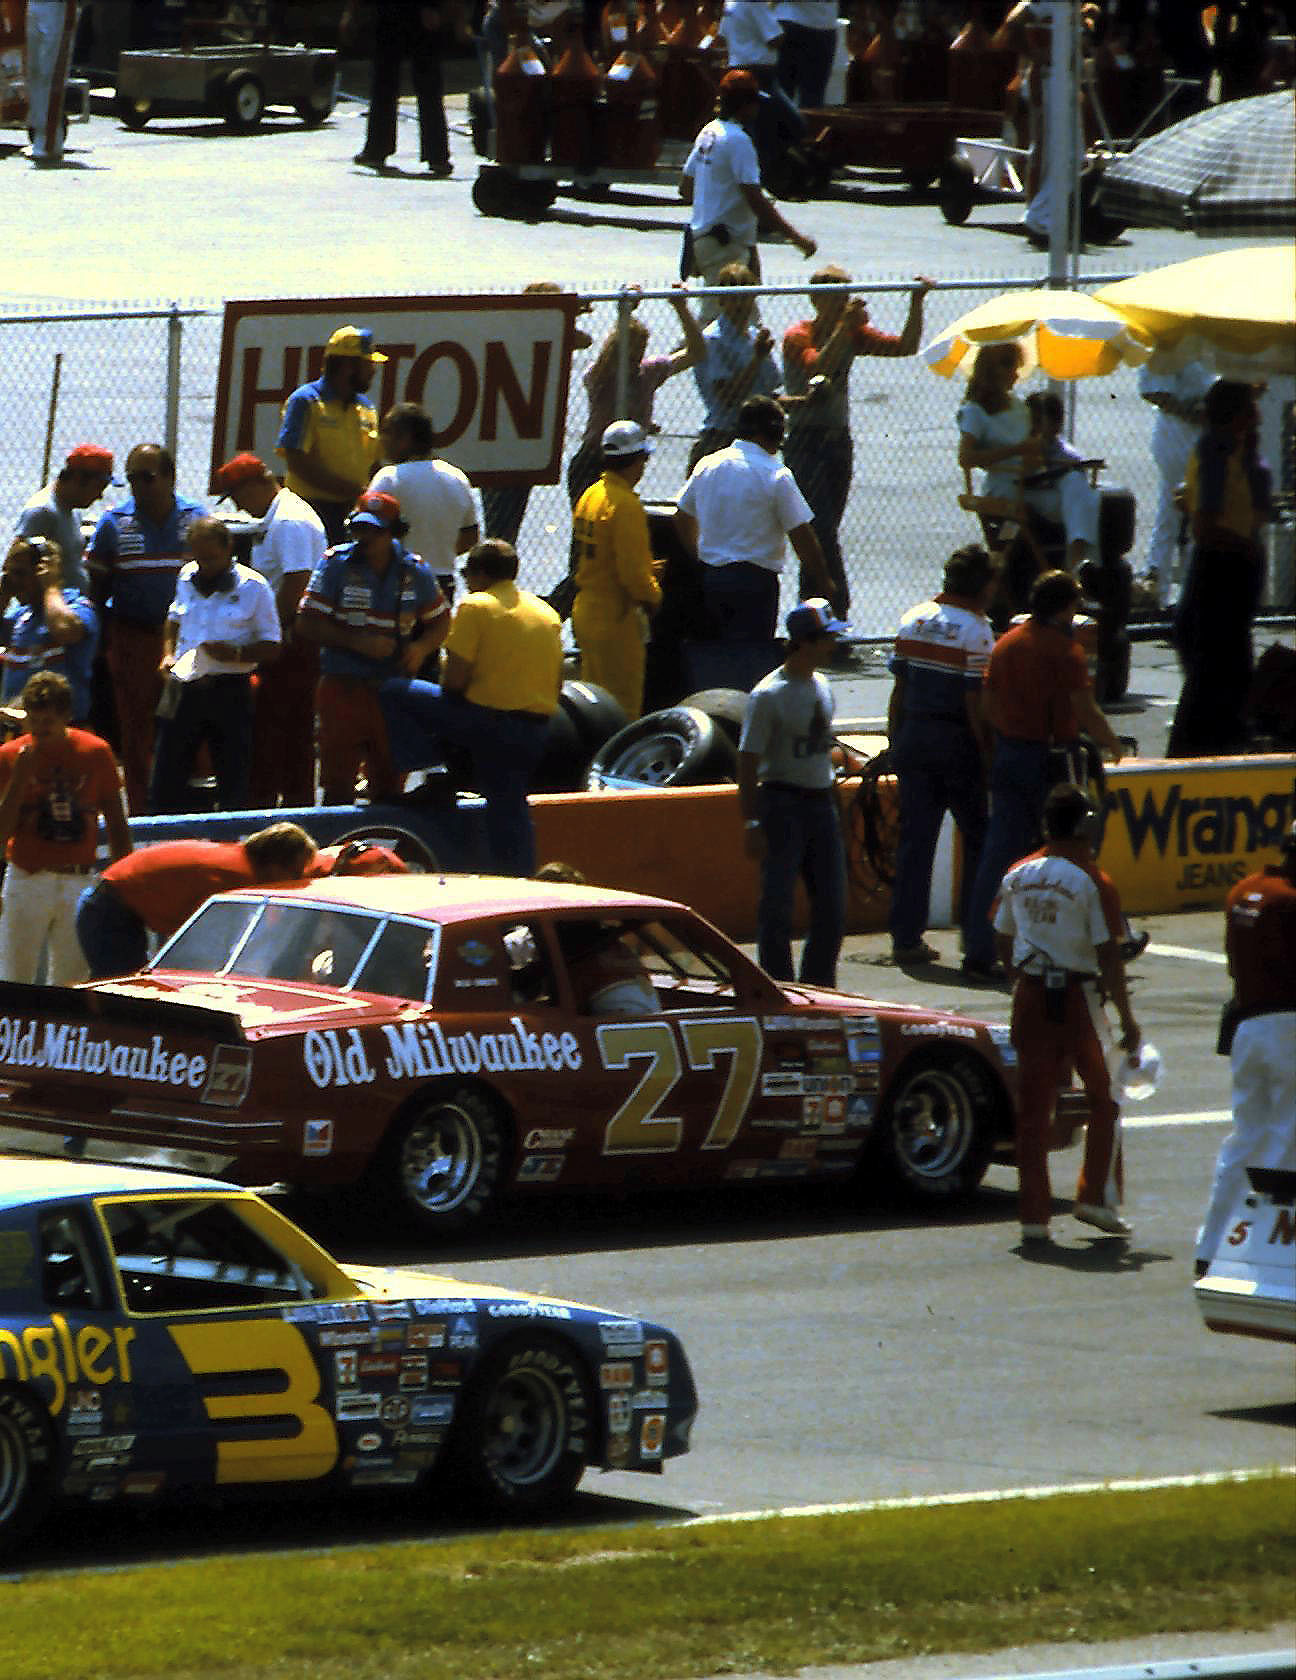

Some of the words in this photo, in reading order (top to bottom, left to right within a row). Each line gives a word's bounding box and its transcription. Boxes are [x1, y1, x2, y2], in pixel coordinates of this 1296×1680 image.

[1119, 784, 1296, 862] Wrang
[1177, 861, 1247, 890] JEANS
[34, 1021, 206, 1090] Milwaukee
[305, 1029, 376, 1089] Old
[384, 1017, 583, 1080] Milwaukee
[596, 1016, 764, 1156] 27
[167, 1319, 340, 1485] 3
